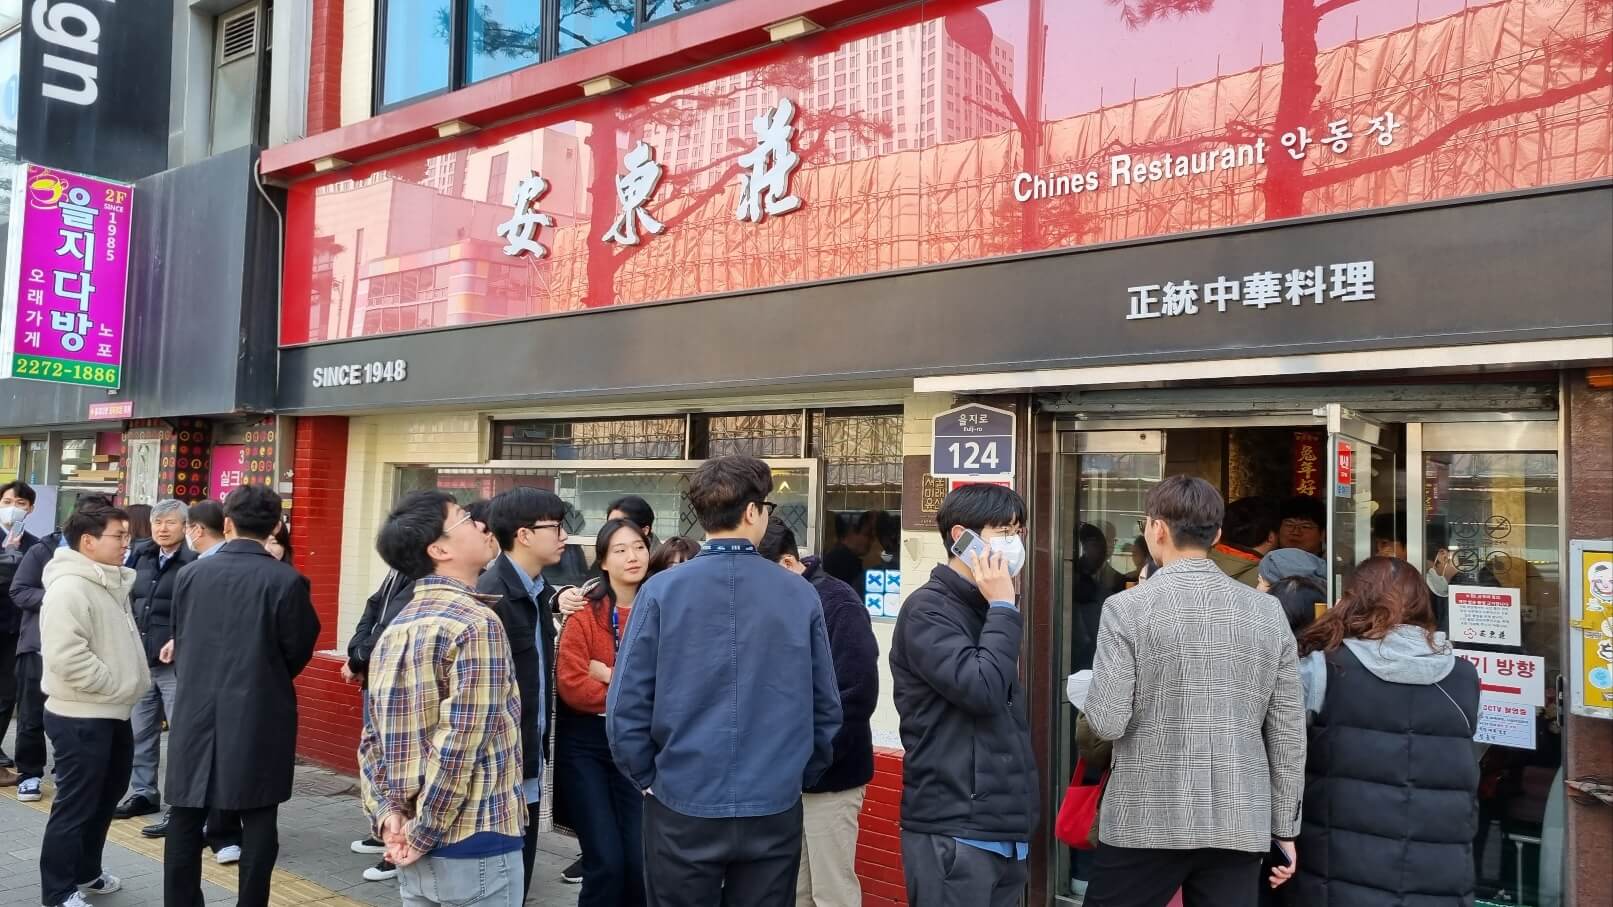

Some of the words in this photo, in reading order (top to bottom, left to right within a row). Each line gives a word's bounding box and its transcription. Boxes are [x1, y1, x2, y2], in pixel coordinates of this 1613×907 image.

[31, 0, 116, 105] gn
[1013, 168, 1099, 202] Chines
[1110, 136, 1266, 187] Restaurant
[104, 188, 127, 204] 2F
[104, 203, 124, 213] SINCE
[106, 212, 117, 261] 1985
[50, 187, 100, 352] 을지다방
[1126, 260, 1377, 320] 正統中華料理
[24, 268, 45, 348] 오래가게
[97, 323, 114, 357] 노포
[16, 358, 116, 383] 2272-1886
[312, 364, 362, 388] SINCE
[364, 359, 407, 384] 1948
[958, 413, 989, 427] 을지로
[948, 441, 999, 469] 124
[220, 470, 243, 487] 실크
[924, 488, 945, 498] 미래
[1496, 658, 1536, 679] 방향
